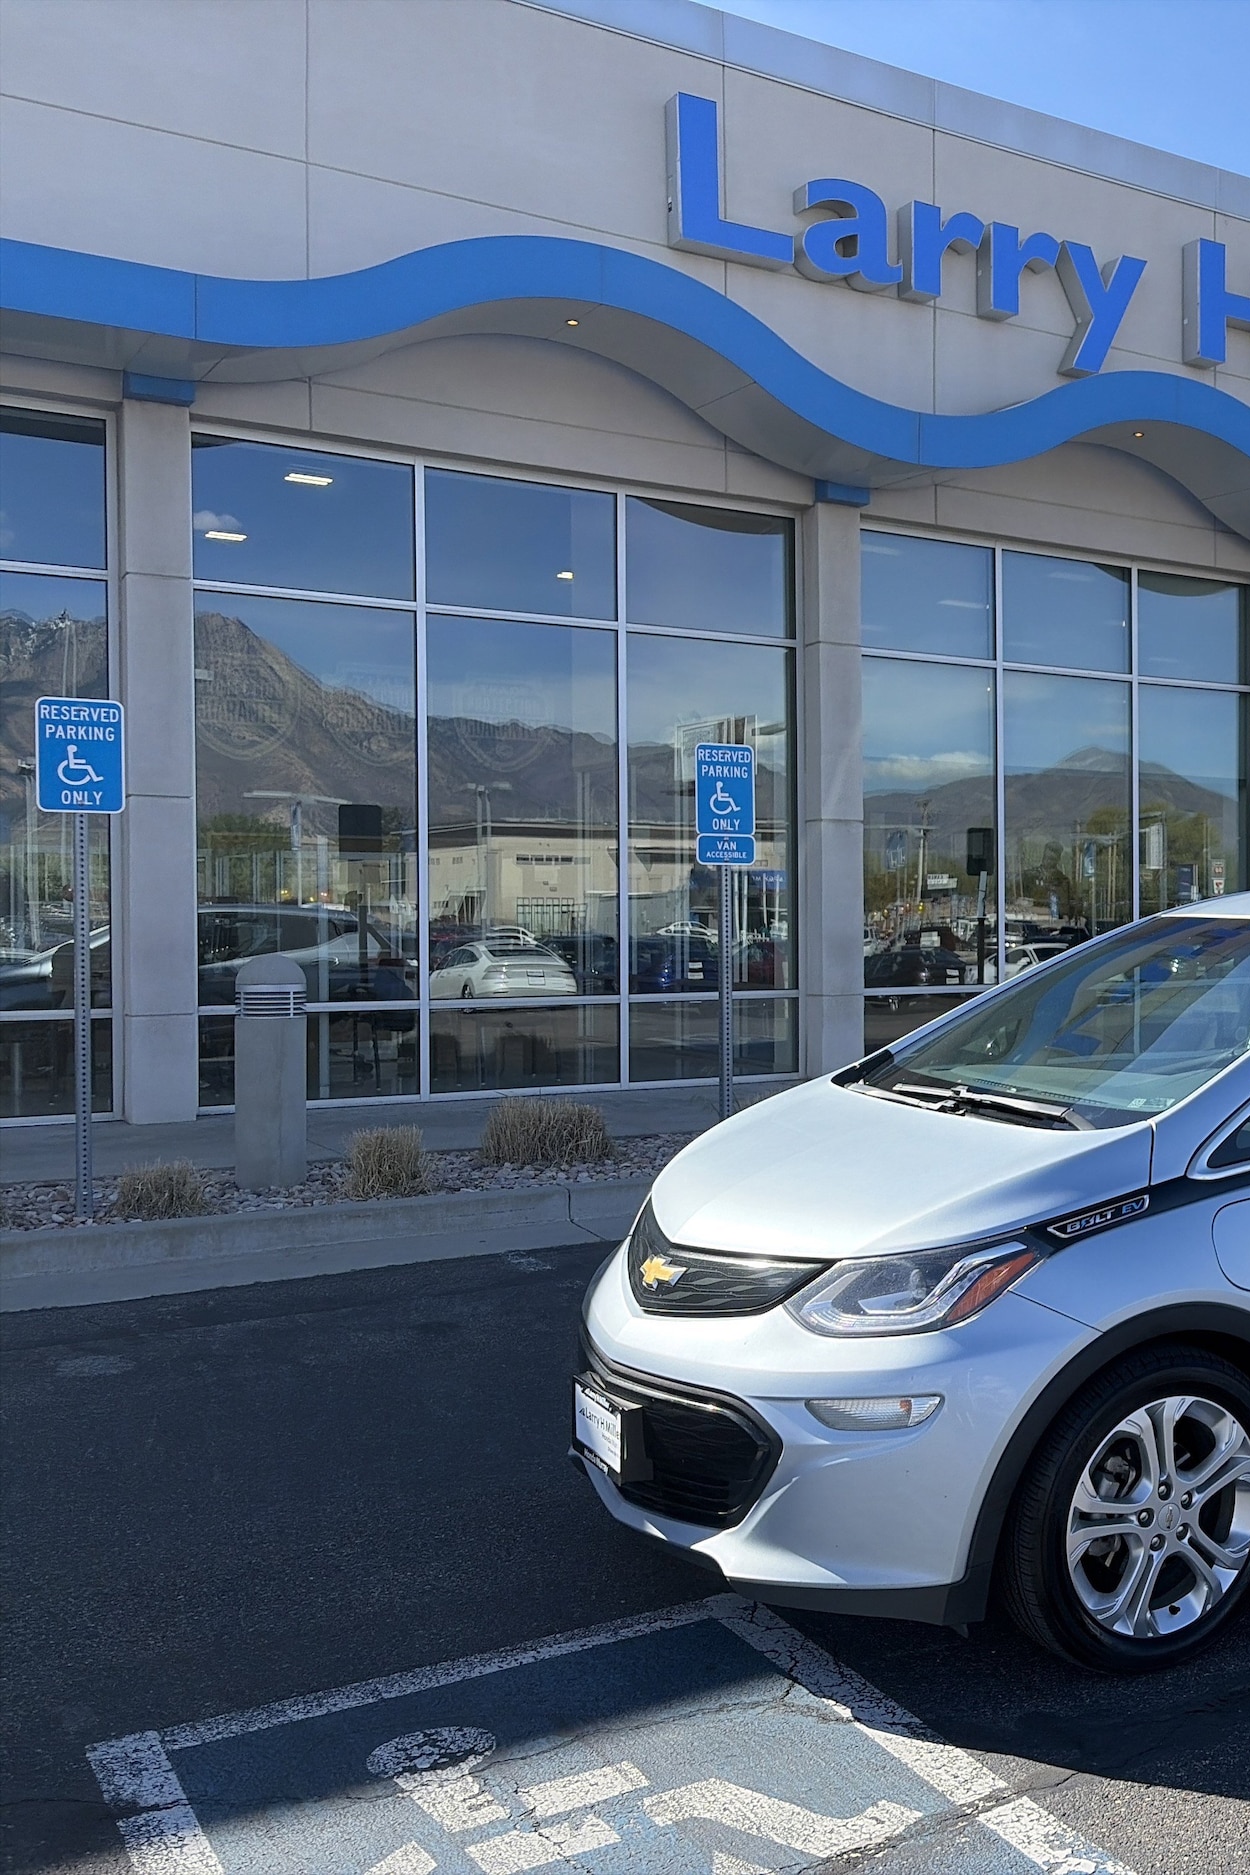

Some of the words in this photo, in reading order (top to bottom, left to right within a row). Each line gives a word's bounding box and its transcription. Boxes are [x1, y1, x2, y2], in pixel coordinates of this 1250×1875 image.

[668, 92, 1147, 377] Larry
[40, 704, 119, 723] RESERVED
[45, 724, 115, 741] PARKING
[698, 749, 751, 763] RESERVED
[701, 765, 748, 778] PARKING
[61, 790, 103, 805] ONLY
[712, 818, 740, 831] ONLY
[717, 841, 737, 850] VAN
[1066, 1208, 1115, 1233] BOLT
[1122, 1199, 1144, 1215] EV
[585, 1406, 600, 1429] Larry
[606, 1420, 620, 1440] Mille
